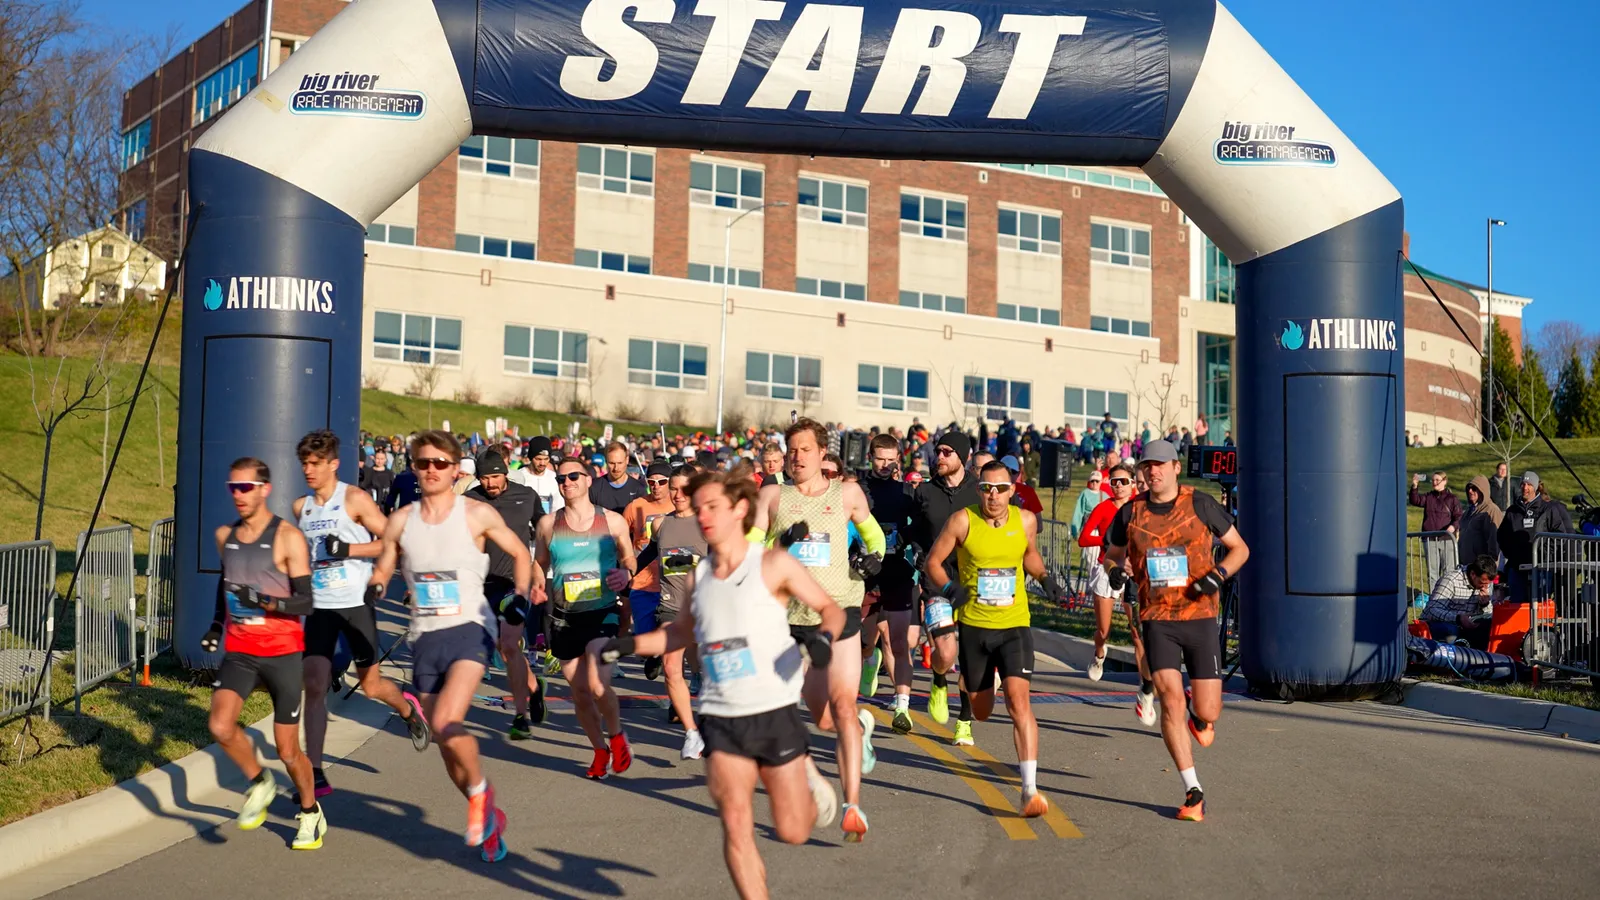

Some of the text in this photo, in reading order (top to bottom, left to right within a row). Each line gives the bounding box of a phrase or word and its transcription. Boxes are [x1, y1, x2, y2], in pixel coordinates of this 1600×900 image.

[560, 0, 1087, 119] START
[299, 71, 379, 92] big river
[296, 94, 419, 113] RACE MANAGEMENT
[1222, 121, 1295, 142] big river
[1221, 145, 1331, 161] RACE MANAGEMENT
[227, 276, 333, 314] ATHLINKS
[1308, 318, 1397, 351] ATHLINKS
[304, 519, 339, 532] LIBERTY
[798, 543, 819, 559] 40
[1155, 558, 1179, 573] 150
[984, 578, 1010, 592] 270
